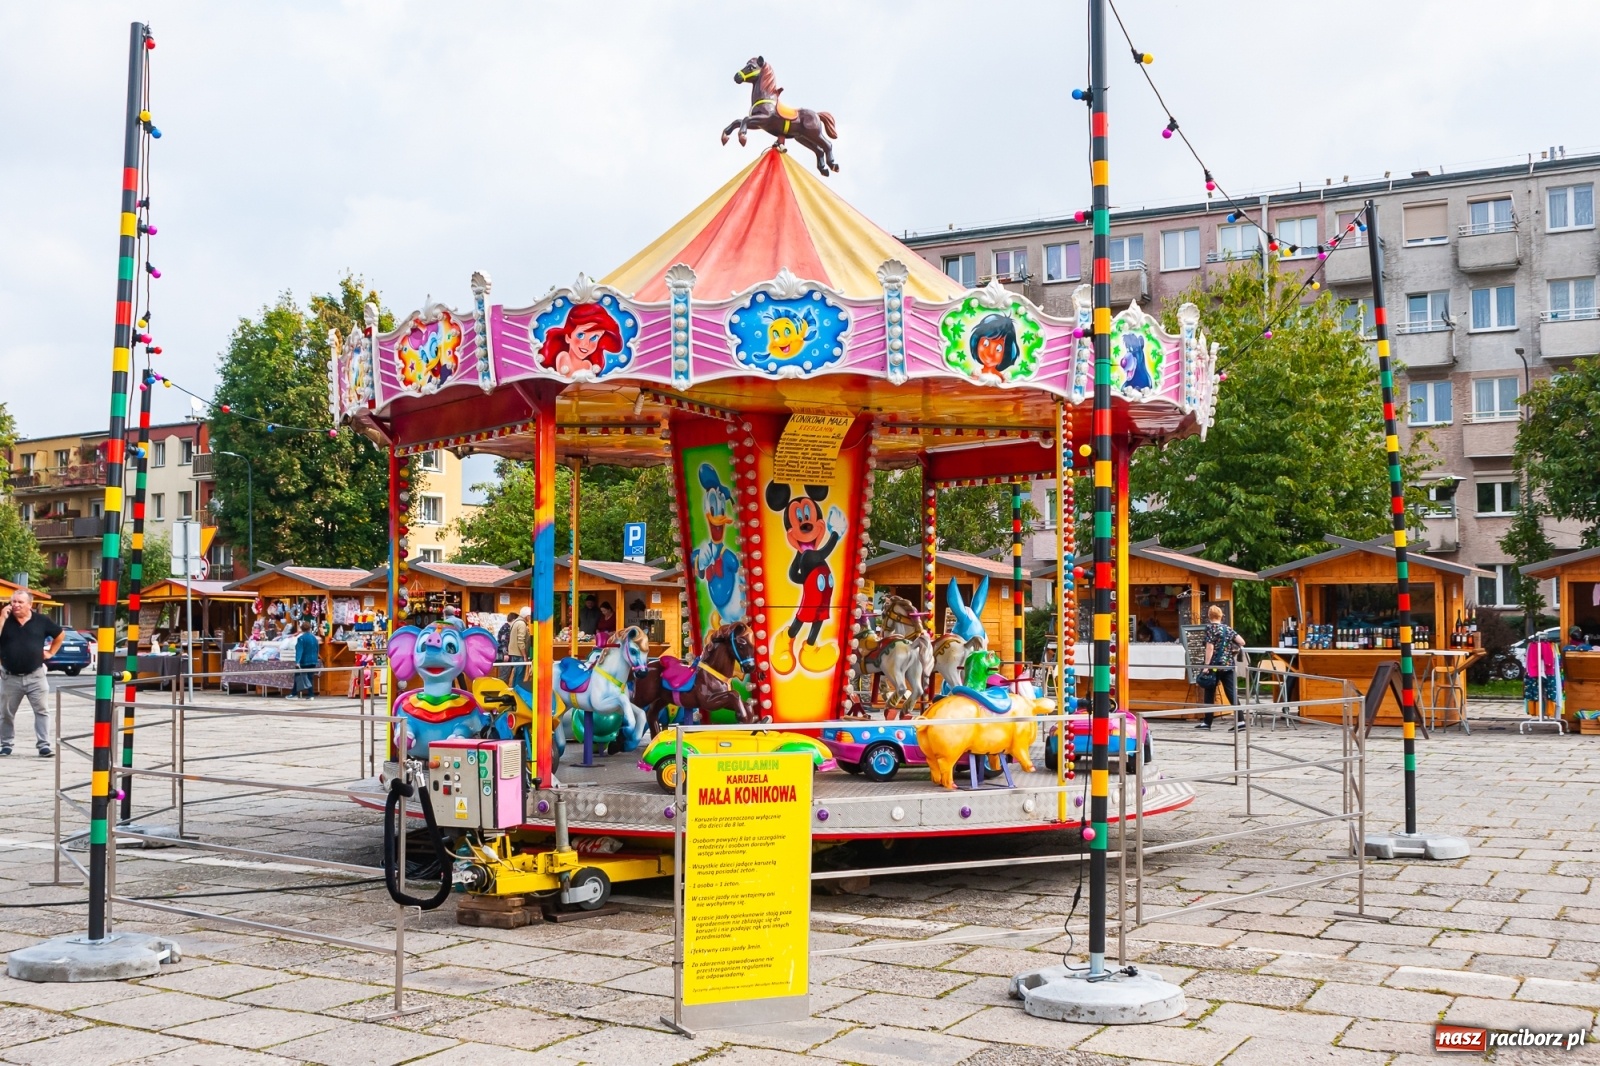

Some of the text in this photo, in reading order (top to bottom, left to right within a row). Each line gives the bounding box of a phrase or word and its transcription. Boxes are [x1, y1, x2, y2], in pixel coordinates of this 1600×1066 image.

[629, 526, 641, 546] P
[717, 760, 780, 771] REGULAMIN
[726, 774, 768, 784] KARUZELA
[698, 785, 797, 806] MAŁA KONIKOWA
[731, 945, 746, 953] jazdy
